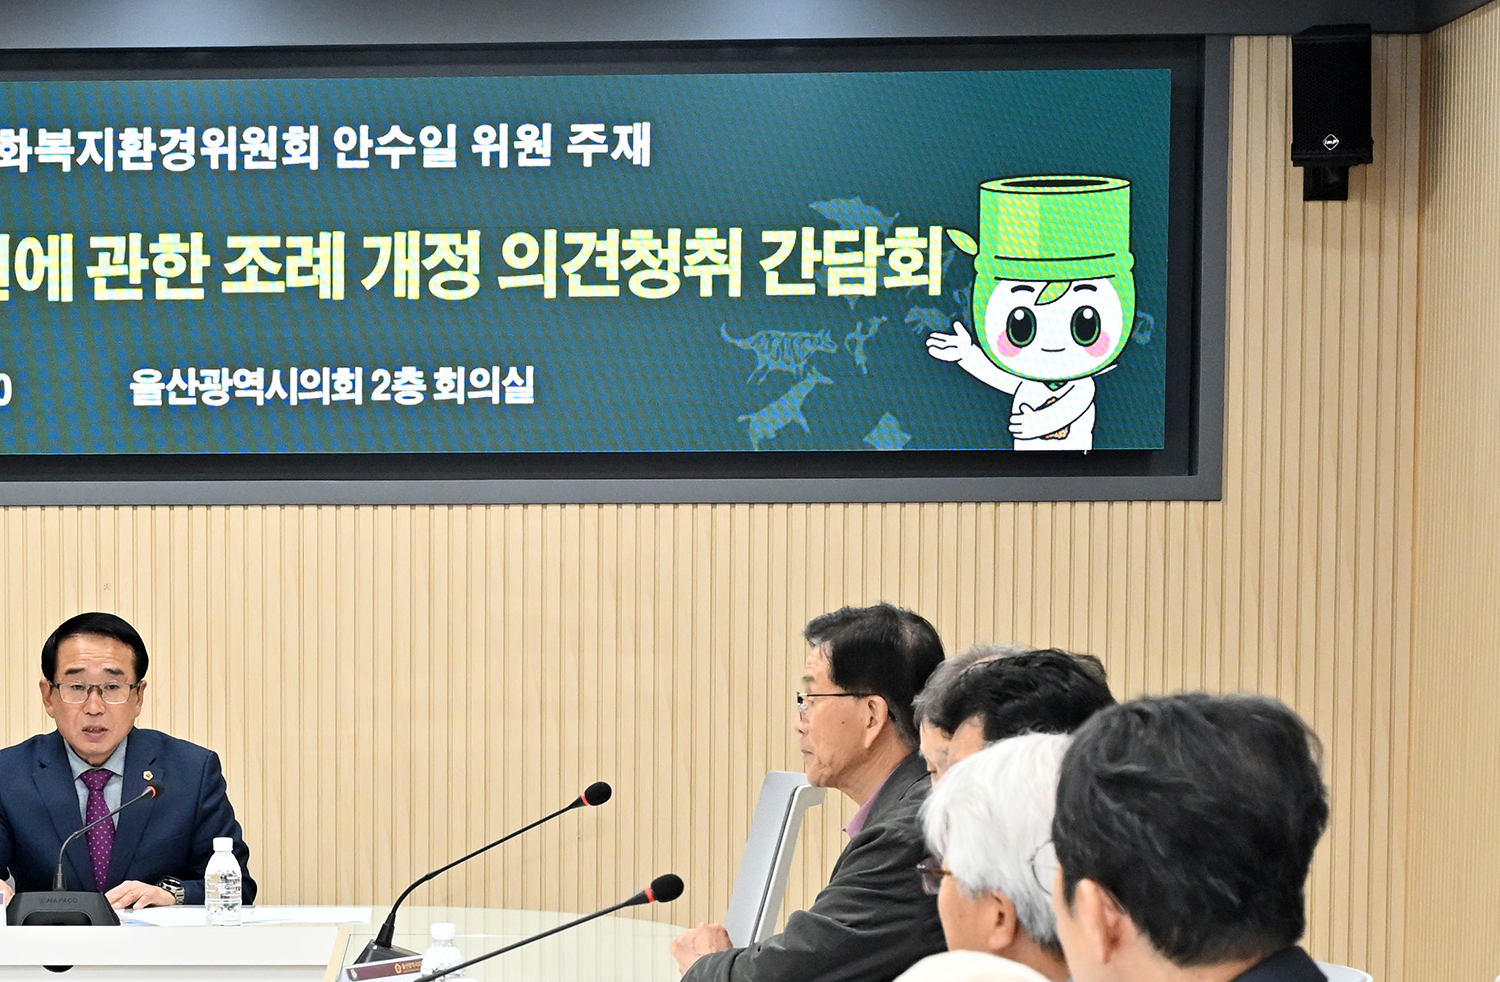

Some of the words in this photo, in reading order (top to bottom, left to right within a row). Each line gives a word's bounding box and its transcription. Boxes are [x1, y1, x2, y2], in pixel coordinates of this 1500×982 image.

[333, 123, 457, 170] 안수일
[471, 122, 553, 169] 위원
[567, 121, 651, 168] 주재
[86, 231, 211, 301] 관한
[221, 230, 346, 301] 조례
[360, 229, 481, 301] 개정
[497, 227, 743, 299] 의견청취
[759, 225, 943, 297] 간담회
[129, 366, 363, 407] 울산광역시의회
[371, 366, 427, 406] 2층
[432, 365, 535, 406] 회의실
